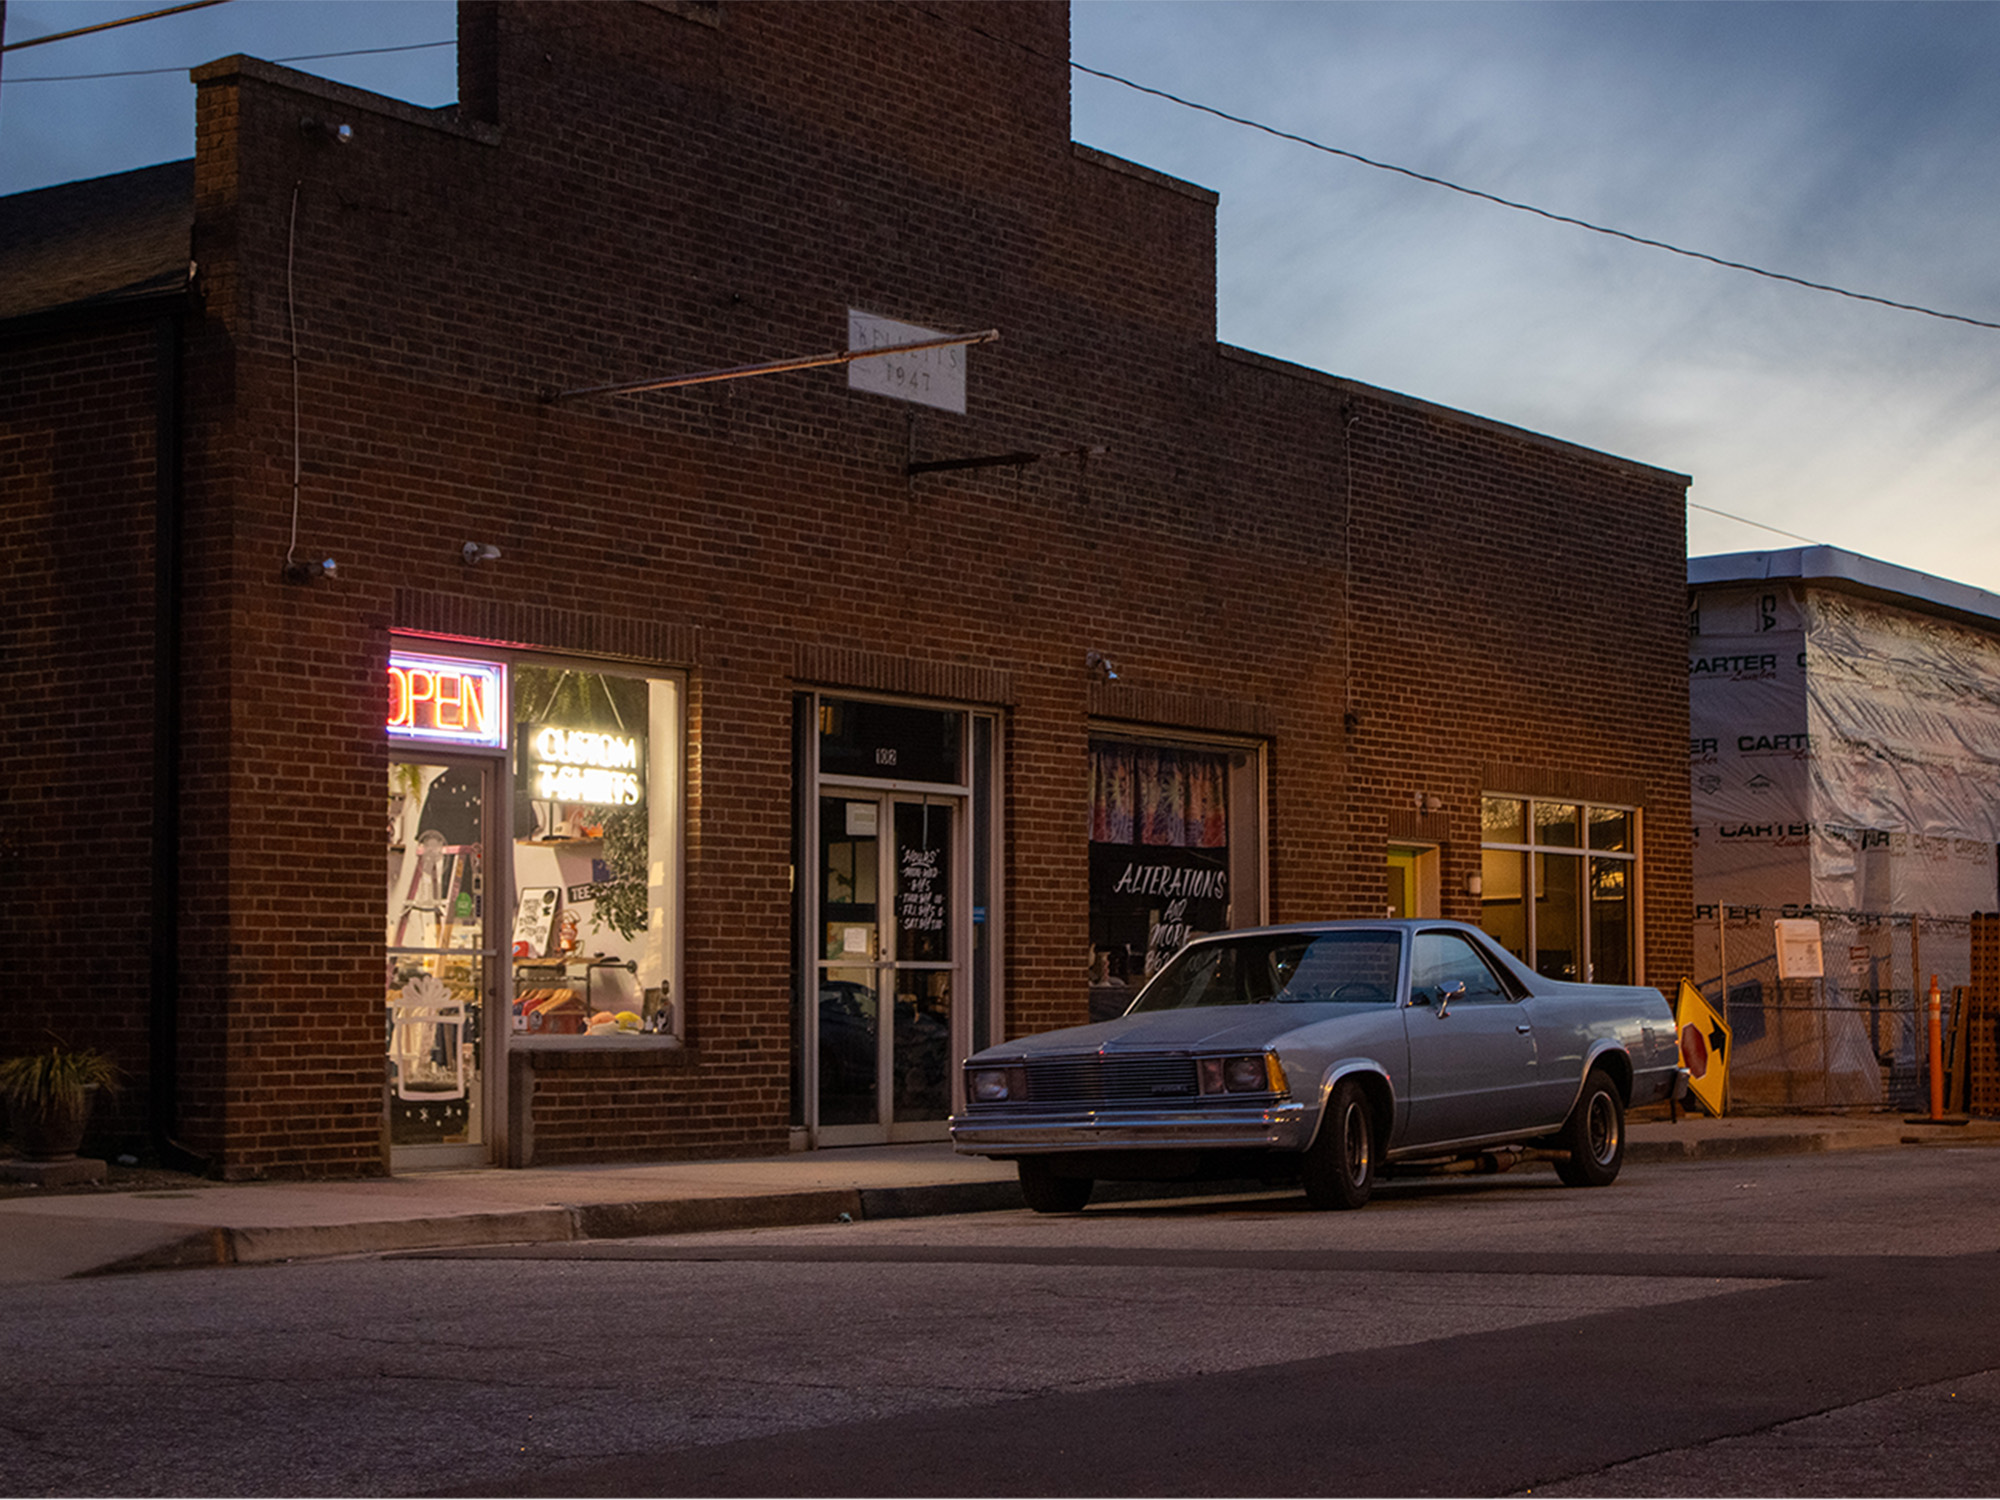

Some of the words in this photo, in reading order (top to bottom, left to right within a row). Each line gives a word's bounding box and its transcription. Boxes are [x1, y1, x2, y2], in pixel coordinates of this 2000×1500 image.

[886, 363, 930, 391] 1947
[537, 728, 636, 768] CUSTOM
[1112, 863, 1227, 899] ALTERATIONS
